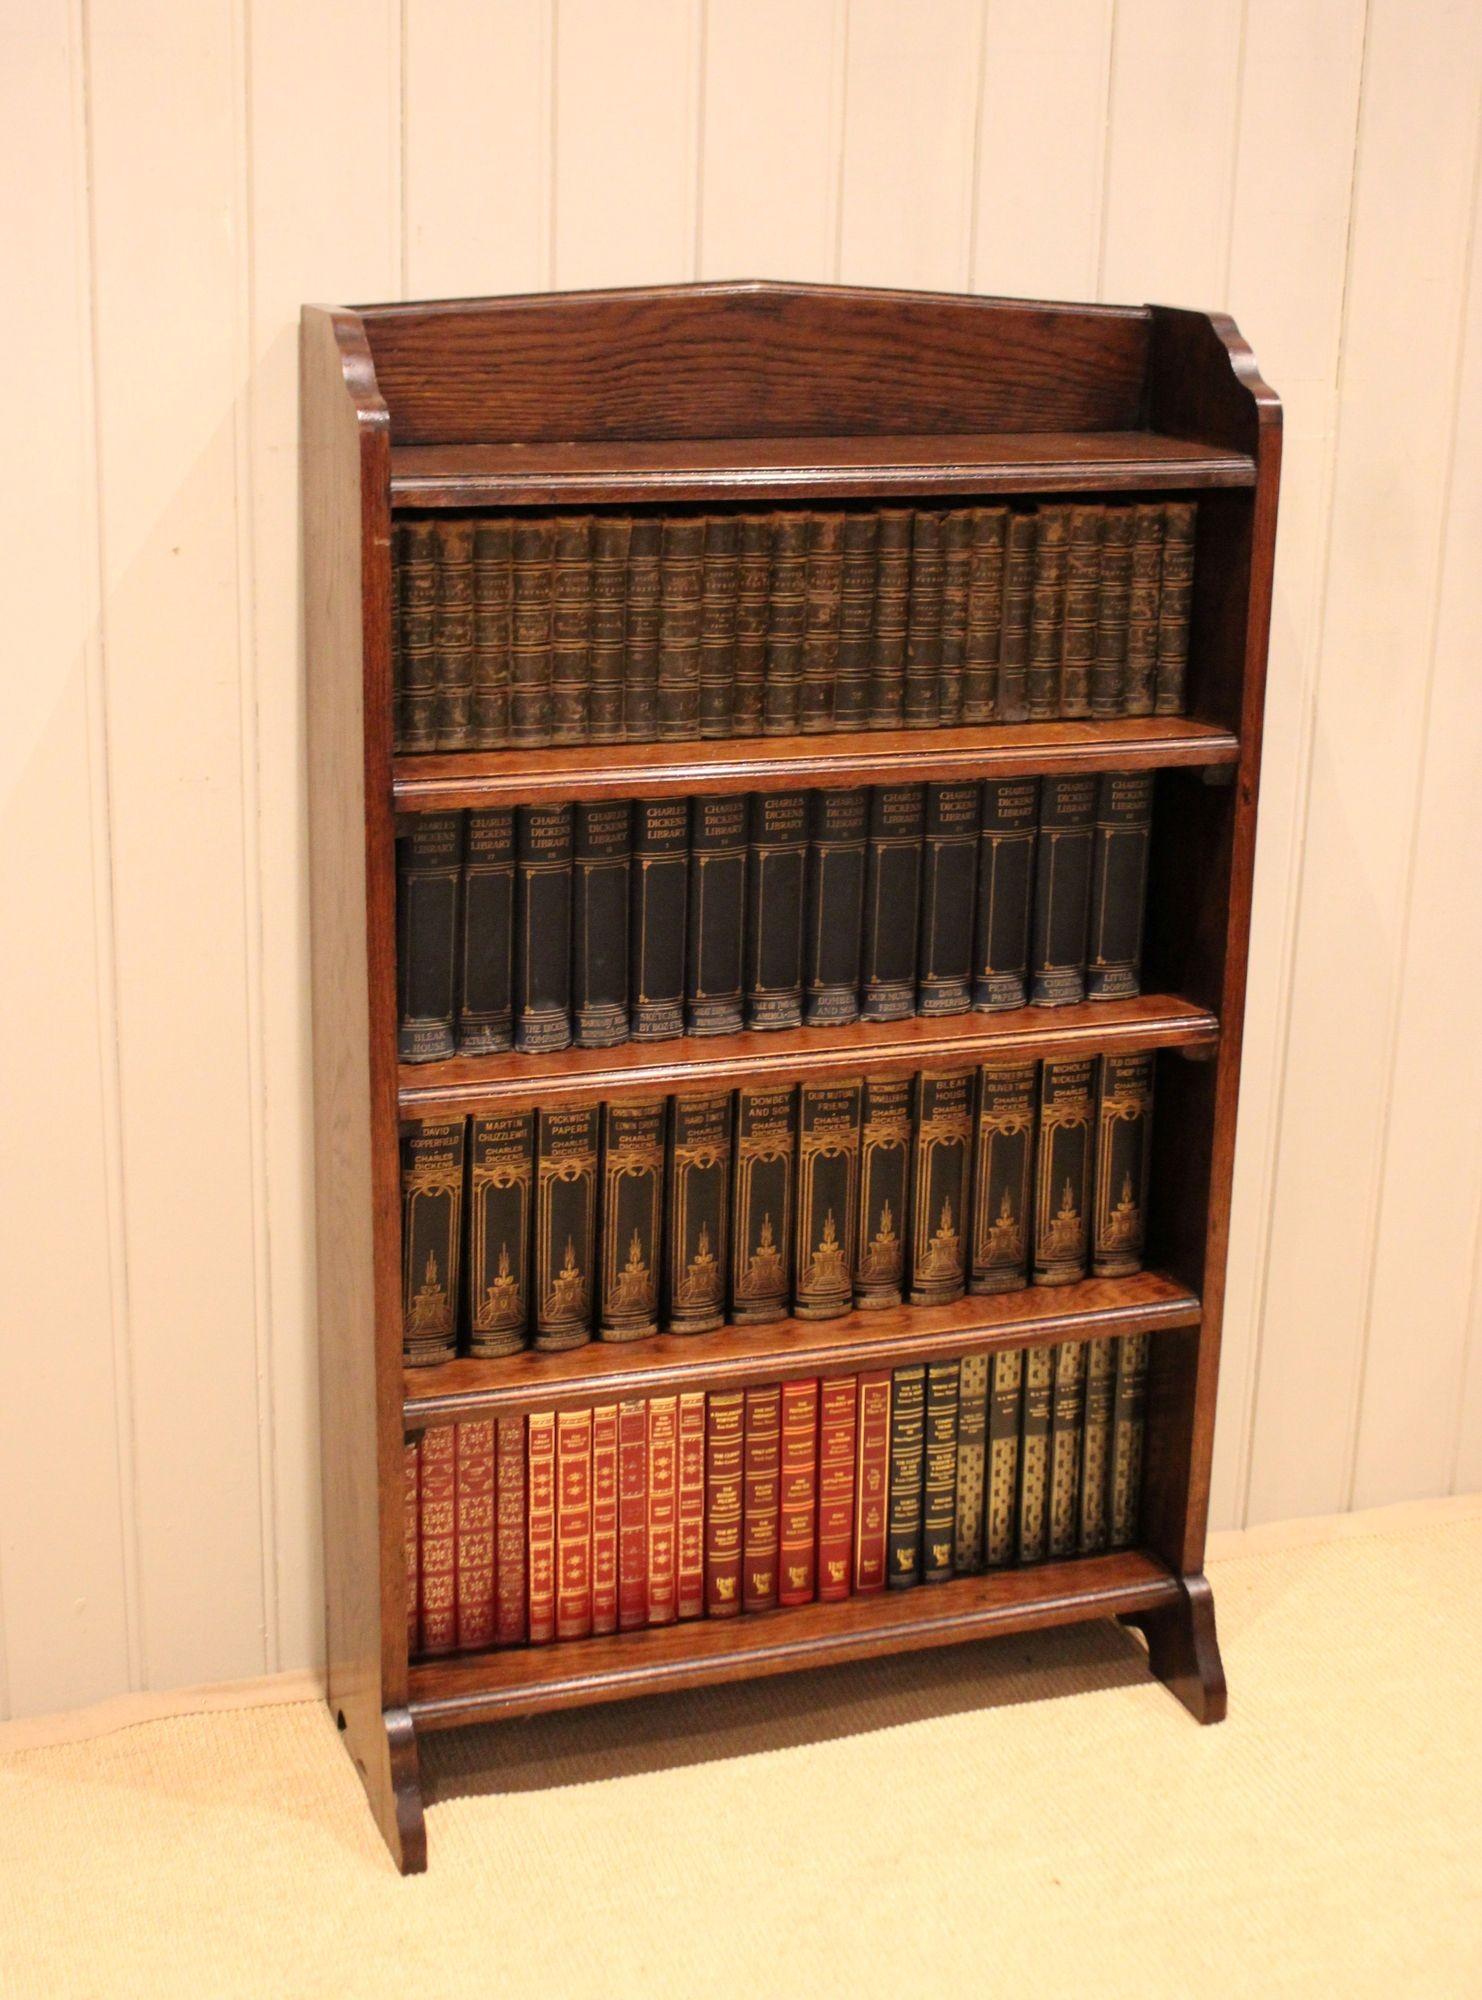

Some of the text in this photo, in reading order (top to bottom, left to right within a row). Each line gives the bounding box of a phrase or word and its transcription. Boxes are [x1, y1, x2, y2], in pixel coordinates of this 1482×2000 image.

[883, 792, 922, 802] CHARLES
[704, 803, 744, 814] CHARLES
[765, 797, 805, 809] CHARLES
[883, 802, 922, 813] DICKENS
[647, 806, 687, 817] CHARLES
[765, 808, 804, 819] DICKENS
[470, 817, 512, 828] CHARLES
[530, 815, 571, 826] CHARLES
[647, 816, 687, 828] DICKENS
[705, 813, 744, 825] DICKENS
[883, 814, 920, 824] LIBRARY
[705, 824, 743, 836] LIBRARY
[765, 819, 803, 831] LIBRARY
[470, 828, 512, 839] DICKENS
[531, 825, 571, 837] DICKENS
[647, 827, 686, 839] LIBRARY
[470, 840, 511, 850] LIBRARY
[531, 837, 570, 848] LIBRARY
[816, 1007, 838, 1016] AND
[936, 1079, 966, 1090] BLEAK
[750, 1095, 791, 1106] DOMBEY
[936, 1089, 966, 1101] HOUSE
[993, 1094, 1029, 1104] CHARLES
[748, 1105, 790, 1117] AND SON
[993, 1102, 1028, 1112] DICKENS
[548, 1112, 591, 1124] PICKWICK
[485, 1119, 523, 1131] MARTIN
[551, 1123, 589, 1135] PAPERS
[751, 1119, 788, 1130] CHARLES
[422, 1126, 450, 1137] DAVID
[478, 1128, 528, 1142] CHUZZLEWIT
[751, 1127, 788, 1138] DICKENS
[409, 1135, 459, 1148] COPPERFIELD
[551, 1138, 589, 1148] CHARLES
[619, 1133, 656, 1143] CHARLES
[485, 1145, 523, 1155] CHARLES
[551, 1145, 589, 1156] DICKENS
[619, 1140, 656, 1151] DICKENS
[414, 1152, 454, 1163] CHARLES
[485, 1152, 524, 1163] DICKENS
[414, 1160, 454, 1171] DICKENS
